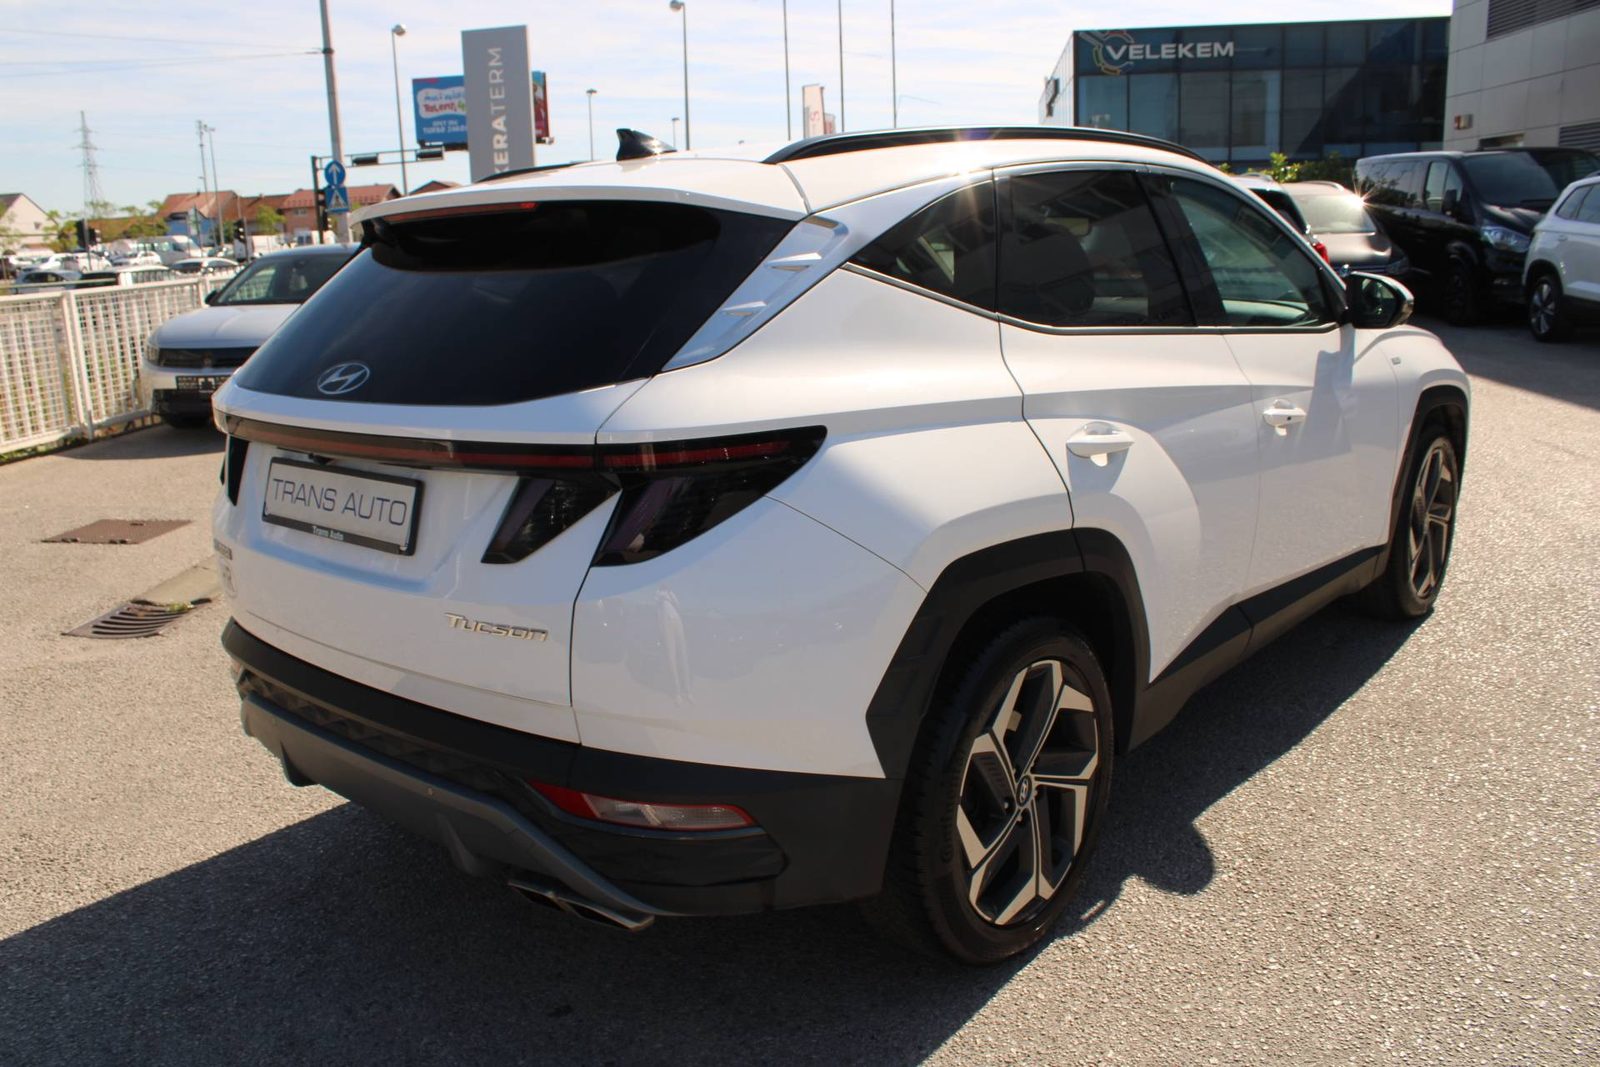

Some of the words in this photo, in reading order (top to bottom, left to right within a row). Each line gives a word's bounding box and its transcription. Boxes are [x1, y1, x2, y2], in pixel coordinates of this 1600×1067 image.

[1105, 41, 1235, 61] VELEKEM
[272, 478, 337, 512] TRANS
[341, 492, 408, 526] AUTO
